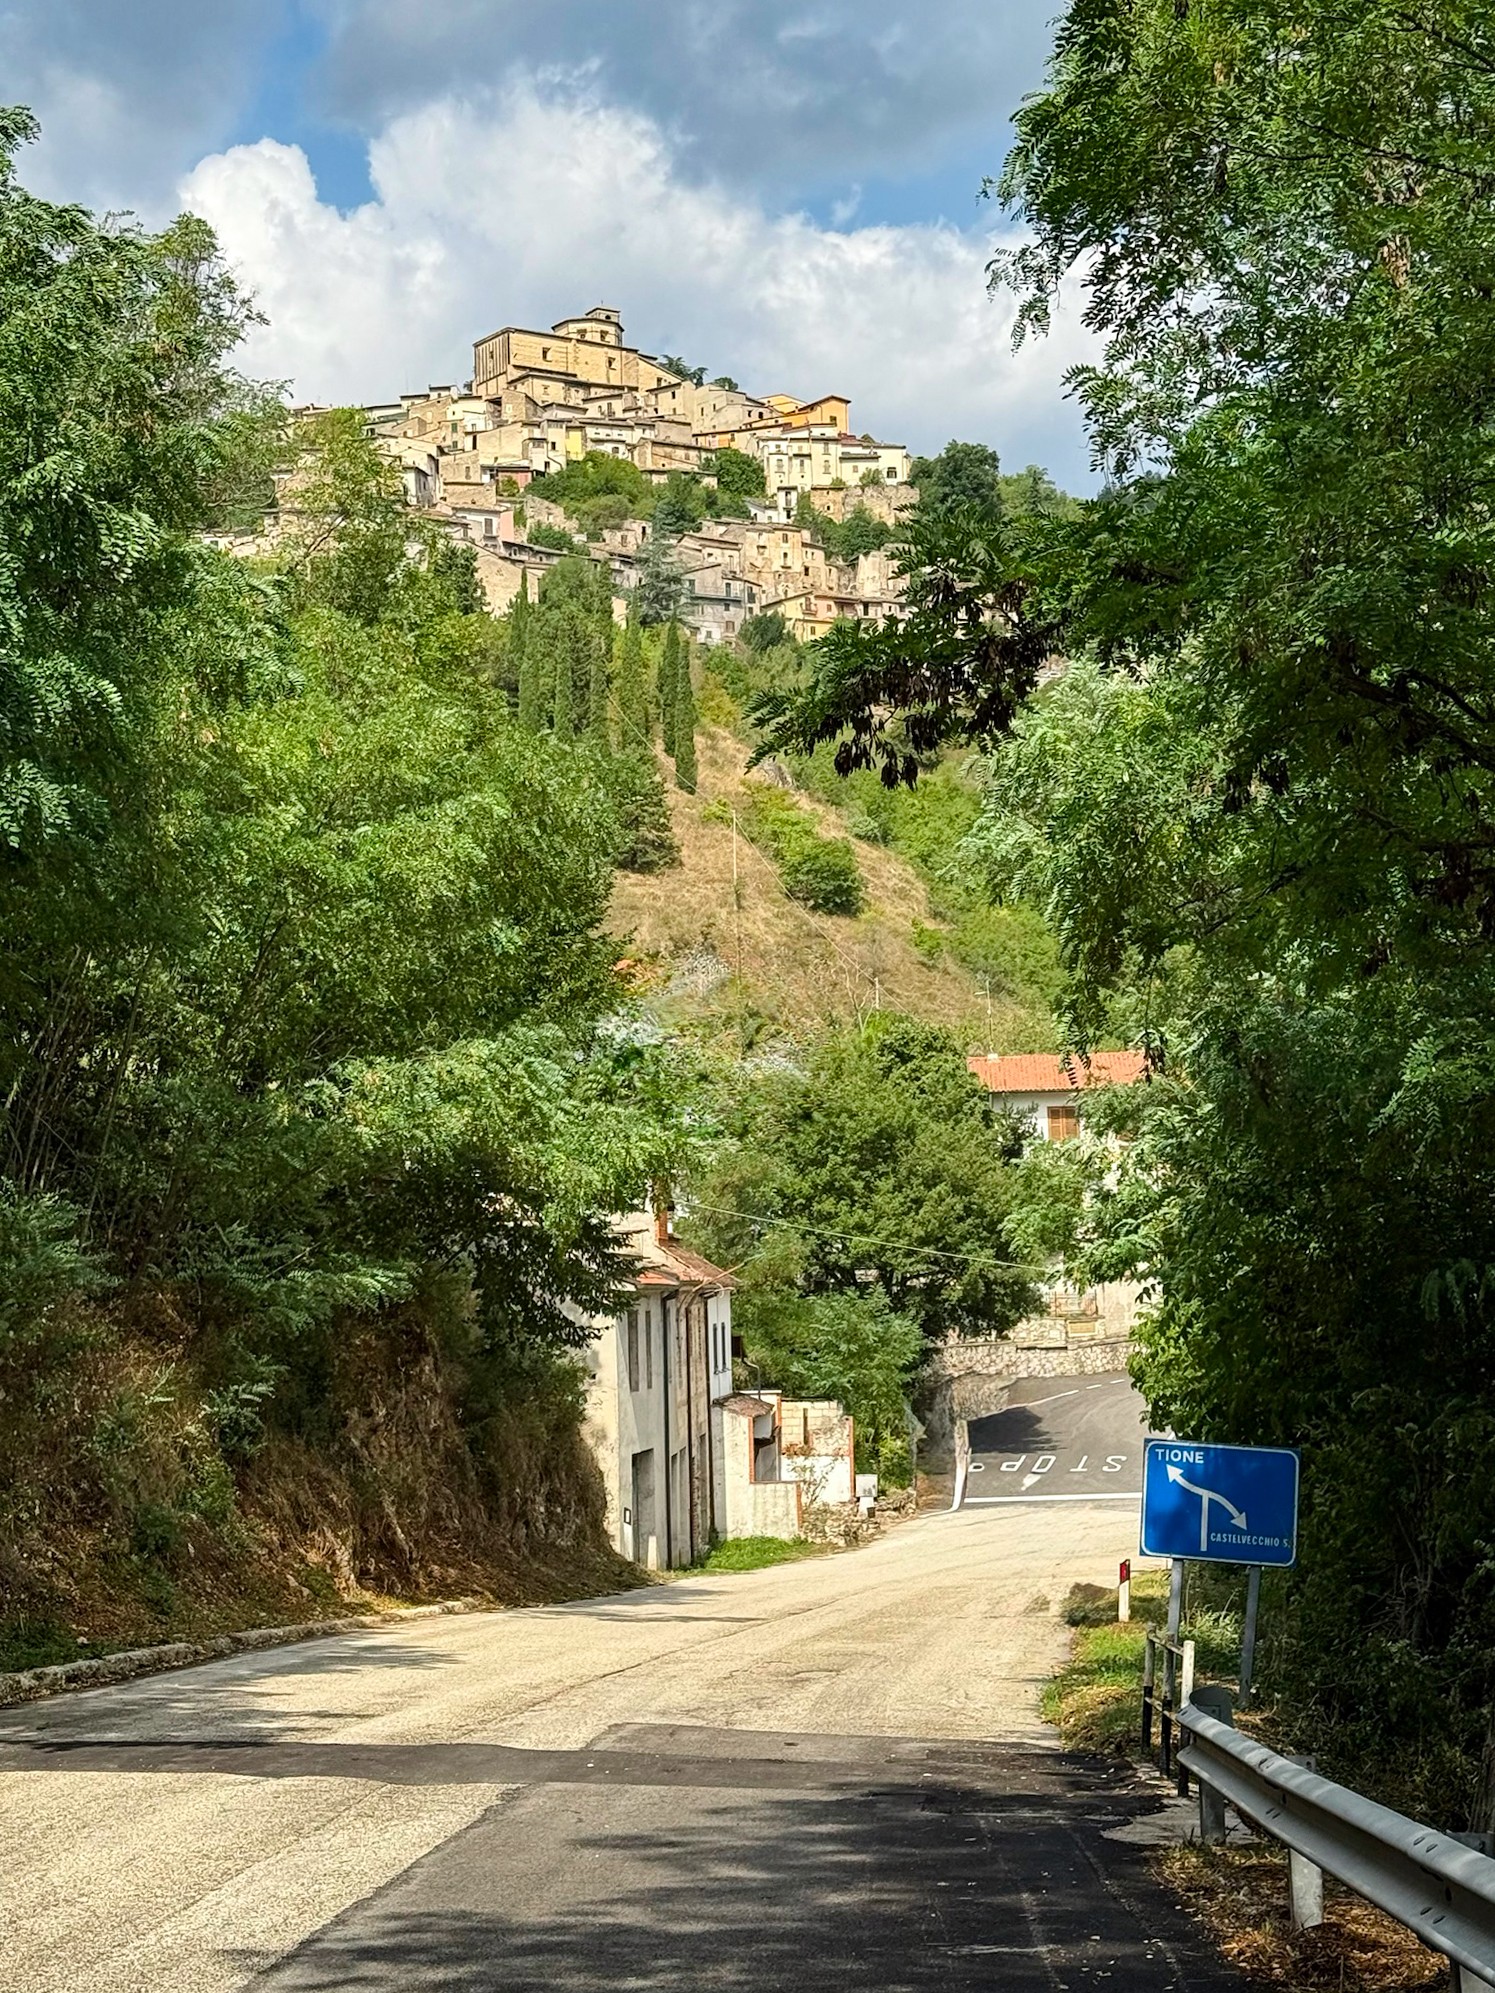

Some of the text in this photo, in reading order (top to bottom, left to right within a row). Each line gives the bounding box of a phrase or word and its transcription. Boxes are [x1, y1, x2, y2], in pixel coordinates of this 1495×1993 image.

[1000, 1455, 1127, 1472] STOP
[1155, 1448, 1205, 1464] TIONE
[1210, 1532, 1291, 1548] CASTELVECCHIO S.
